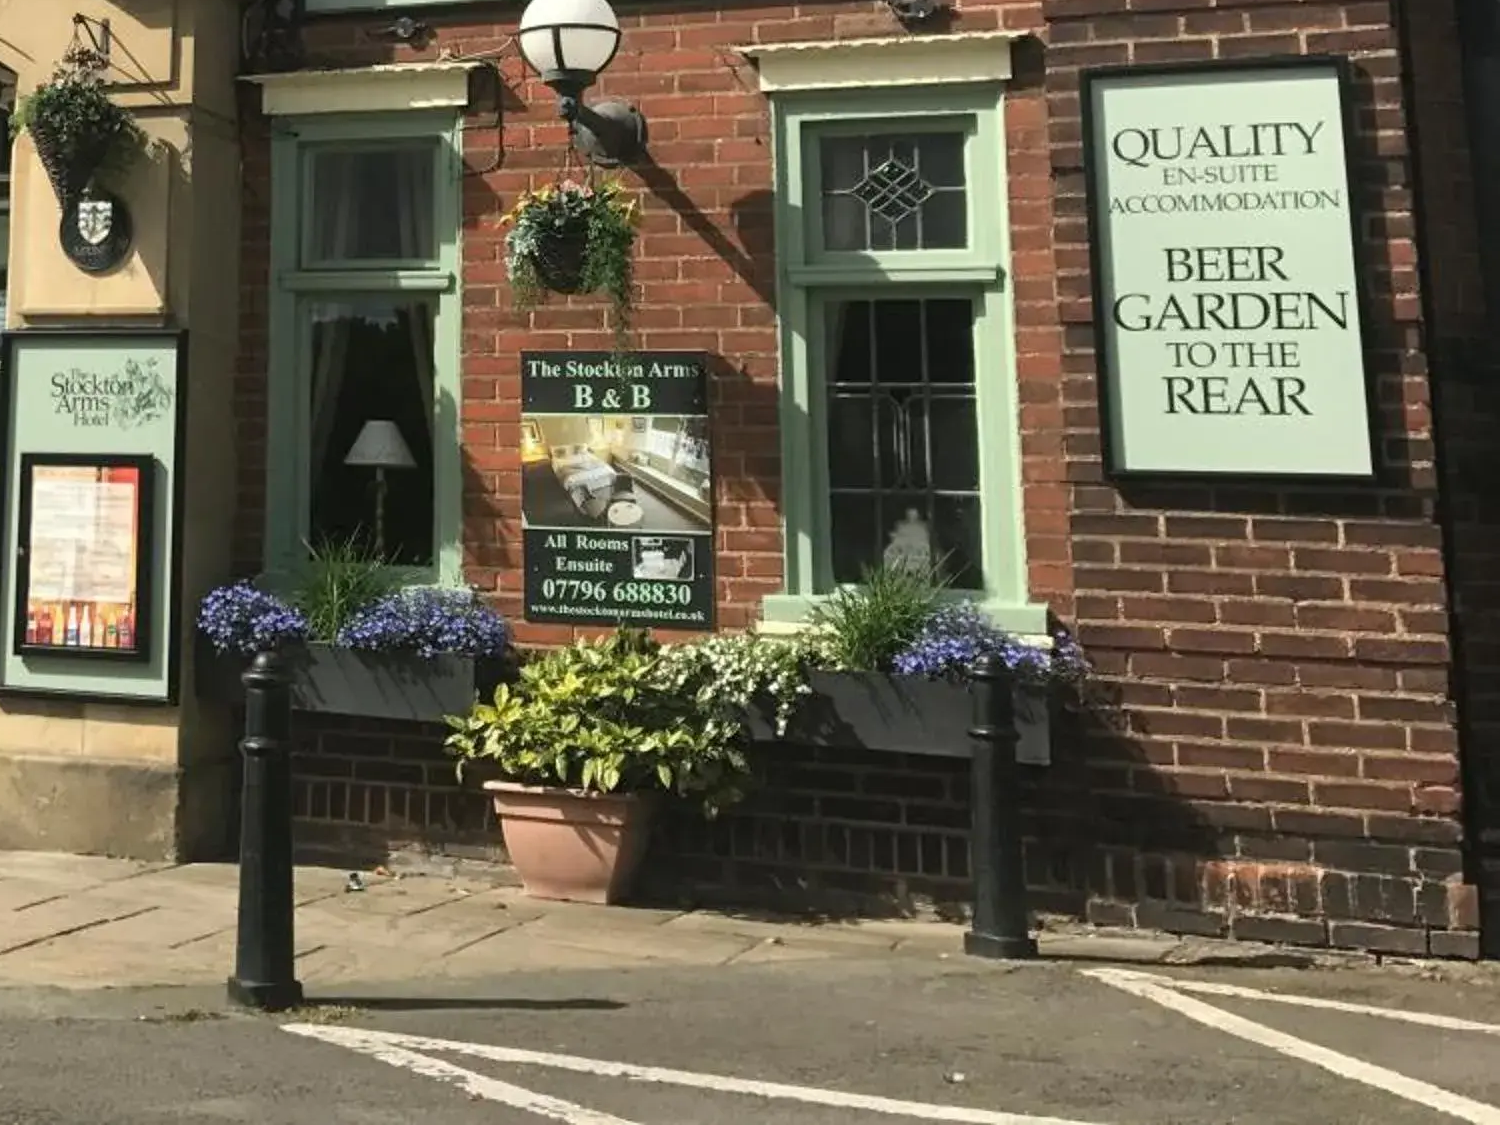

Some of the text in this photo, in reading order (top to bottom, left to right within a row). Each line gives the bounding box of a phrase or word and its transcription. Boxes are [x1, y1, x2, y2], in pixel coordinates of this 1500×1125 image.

[1112, 121, 1324, 167] QUALITY
[1162, 164, 1279, 186] EN-SUITE
[1108, 190, 1341, 215] ACCOMMODATION
[1162, 246, 1291, 282] BEER
[1112, 291, 1349, 332] GARDEN
[1165, 342, 1301, 368] TO THE
[528, 360, 699, 378] The Stockton Arms
[51, 373, 135, 397] Stockton
[573, 384, 651, 408] B & B
[1161, 376, 1314, 415] REAR
[54, 394, 111, 414] Arms
[73, 411, 109, 426] Hotel
[544, 534, 629, 552] All Rooms
[555, 557, 613, 573] Ensuite
[542, 578, 692, 606] 07796 688830
